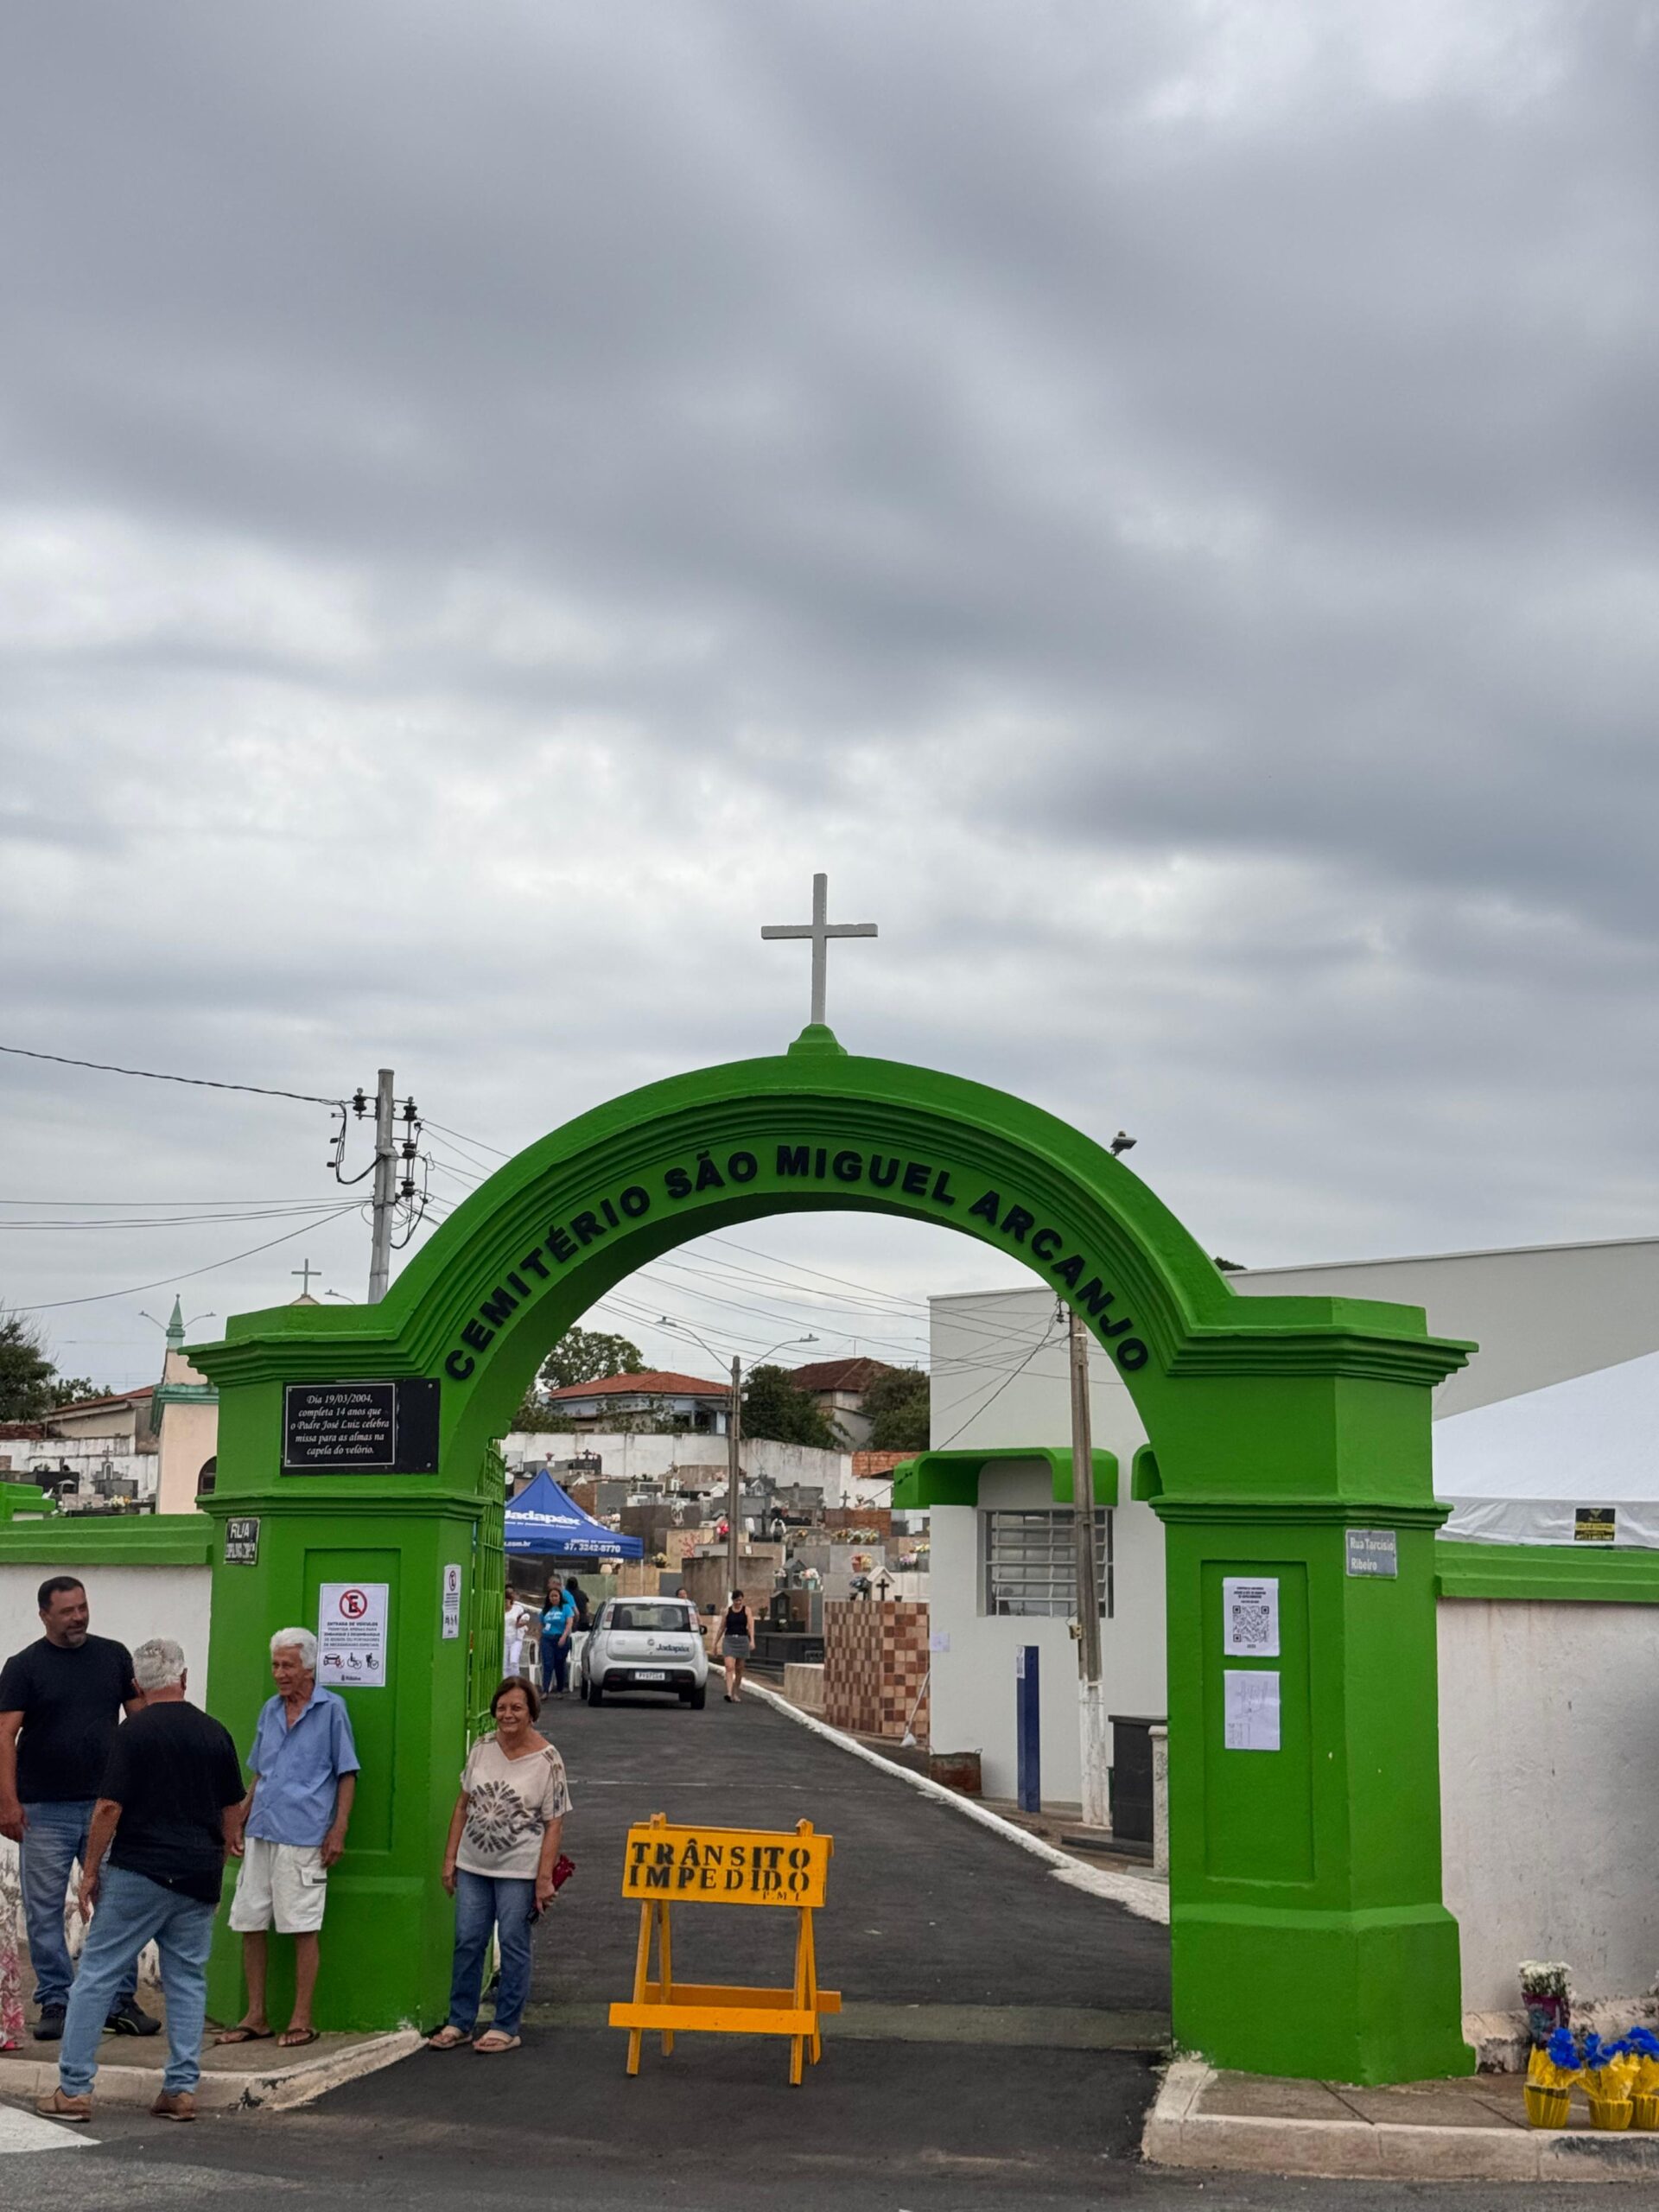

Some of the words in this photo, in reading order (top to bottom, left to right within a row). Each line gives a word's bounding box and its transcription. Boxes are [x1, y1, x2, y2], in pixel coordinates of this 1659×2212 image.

[444, 1185, 651, 1380] CEMITÉRIO
[664, 1150, 758, 1199] SÃO
[777, 1145, 956, 1205] MIGUEL
[969, 1190, 1149, 1371] ARCANJO
[306, 1395, 322, 1404] Dia
[298, 1407, 334, 1420] completa
[367, 1408, 382, 1418] que
[297, 1420, 321, 1430] Padre
[321, 1420, 339, 1431] José
[340, 1420, 359, 1429] Luiz
[361, 1418, 390, 1428] celebra
[296, 1433, 317, 1443] missa
[318, 1435, 337, 1445] para
[349, 1432, 372, 1442] almas
[307, 1446, 332, 1457] capela
[334, 1445, 344, 1454] do
[230, 1522, 250, 1539] RUA
[1350, 1537, 1364, 1549] Rua
[1351, 1557, 1377, 1571] Ribeiro
[632, 1838, 810, 1870] TRÂNSITO
[629, 1865, 810, 1893] IMPEDIDO
